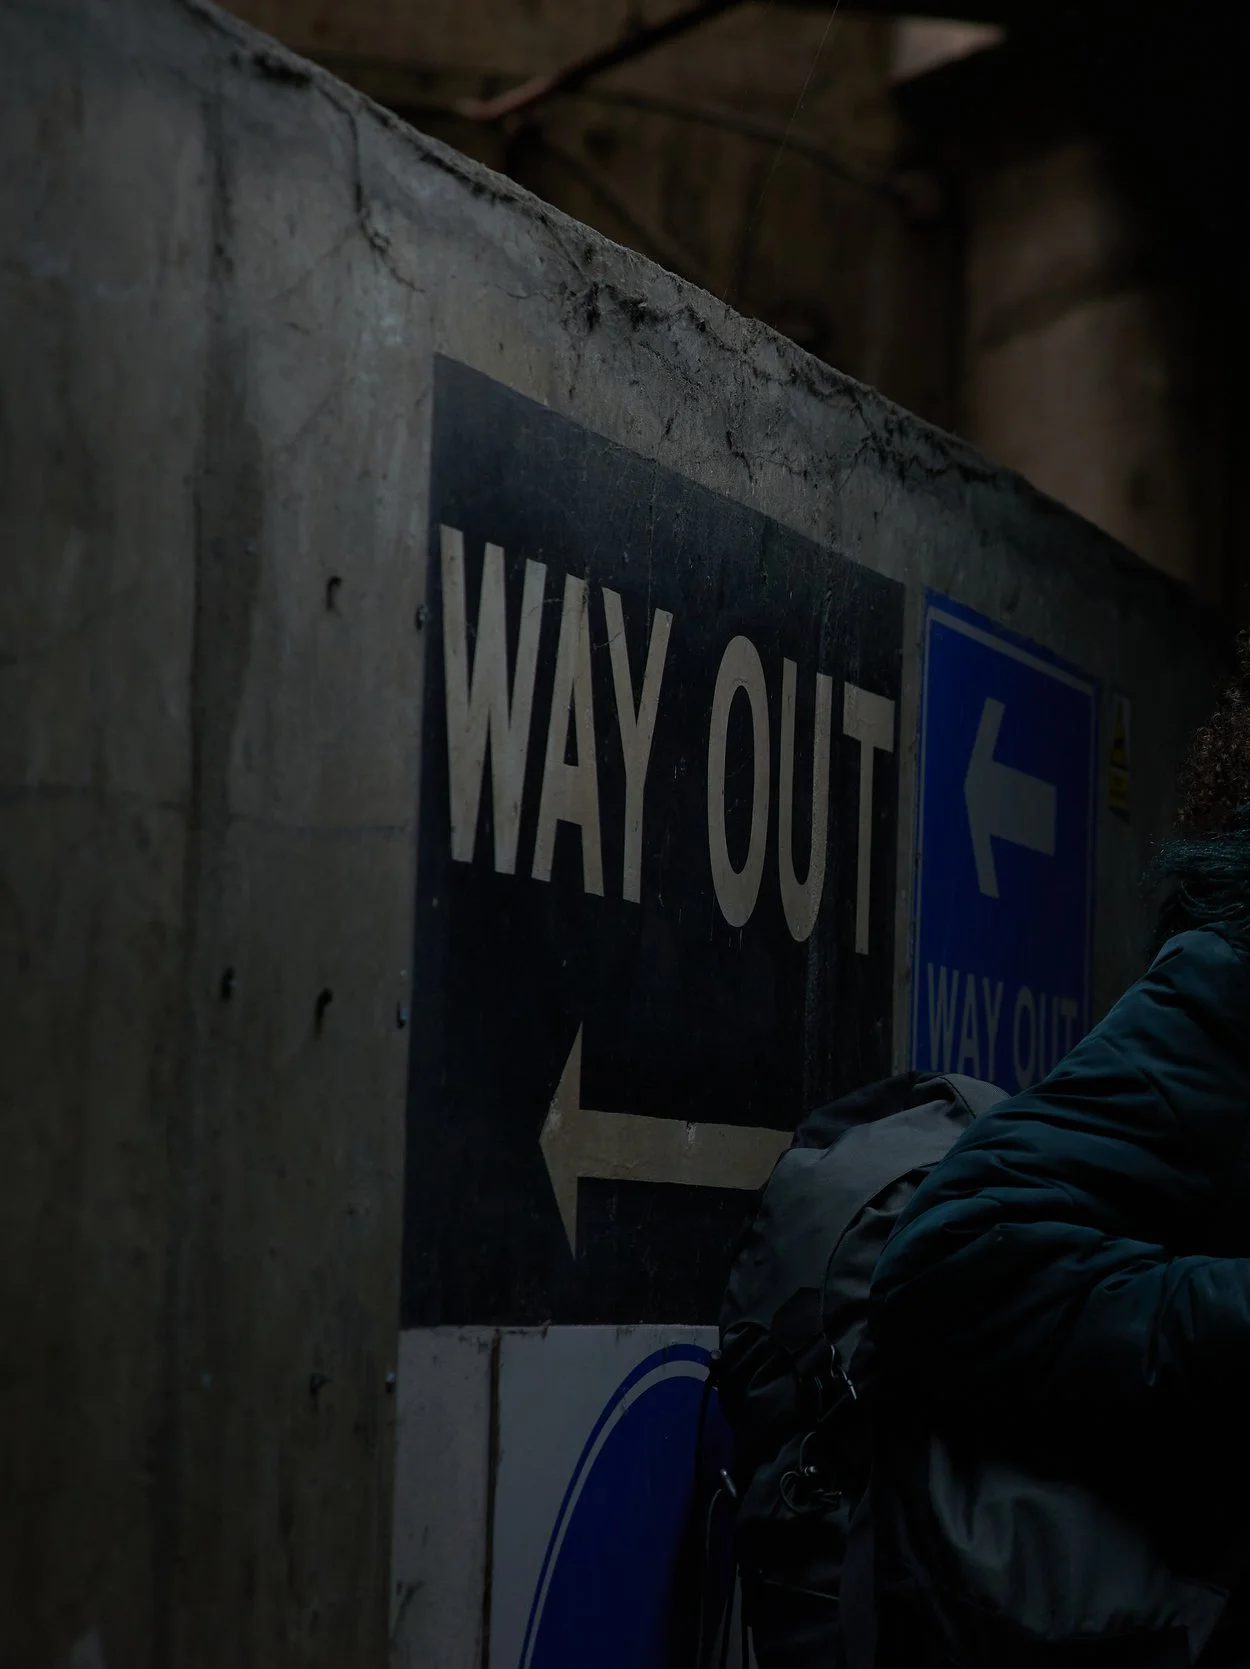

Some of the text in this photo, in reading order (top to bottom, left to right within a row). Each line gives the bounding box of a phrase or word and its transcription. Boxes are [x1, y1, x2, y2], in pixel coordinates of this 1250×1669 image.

[440, 524, 896, 956] WAY OUT
[927, 962, 1004, 1082] WAY
